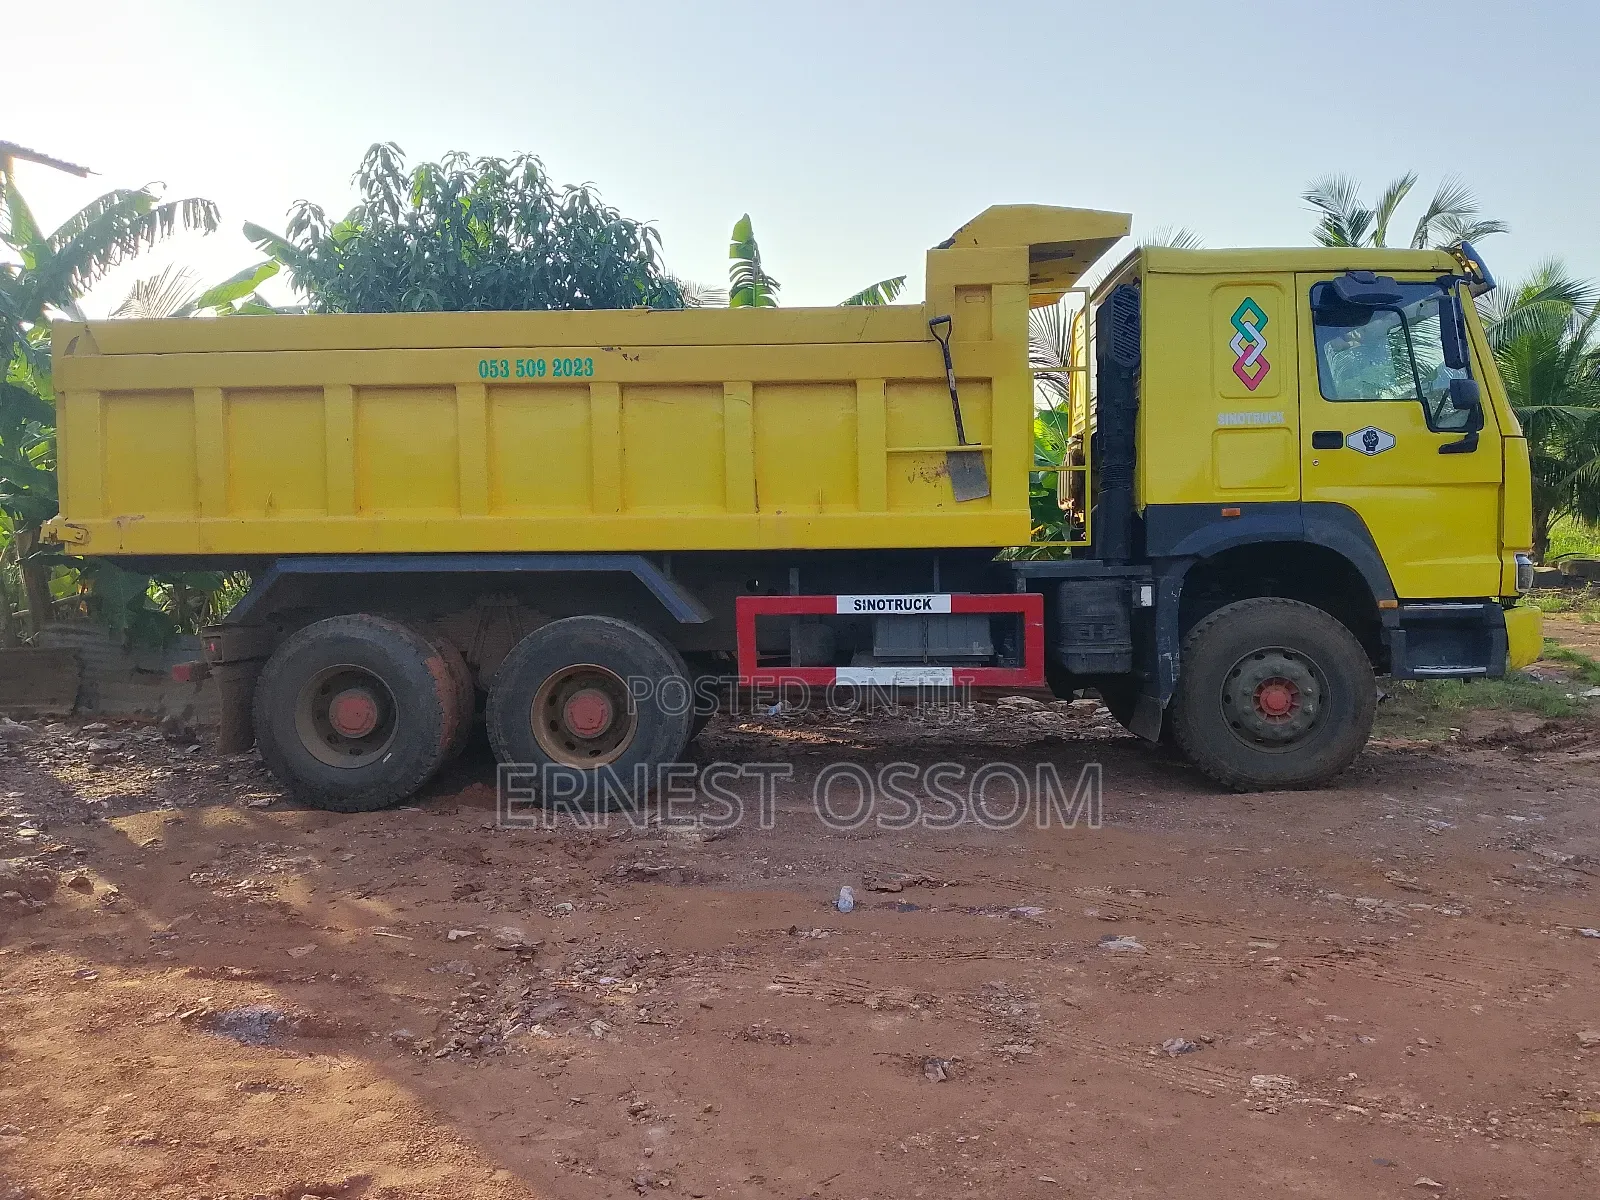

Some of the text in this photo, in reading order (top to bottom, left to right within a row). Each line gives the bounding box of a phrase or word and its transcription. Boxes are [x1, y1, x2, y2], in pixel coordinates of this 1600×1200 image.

[478, 357, 594, 379] 053 509 2023
[1217, 411, 1286, 425] SINOTRUCK
[853, 598, 932, 611] SINOTRUCK
